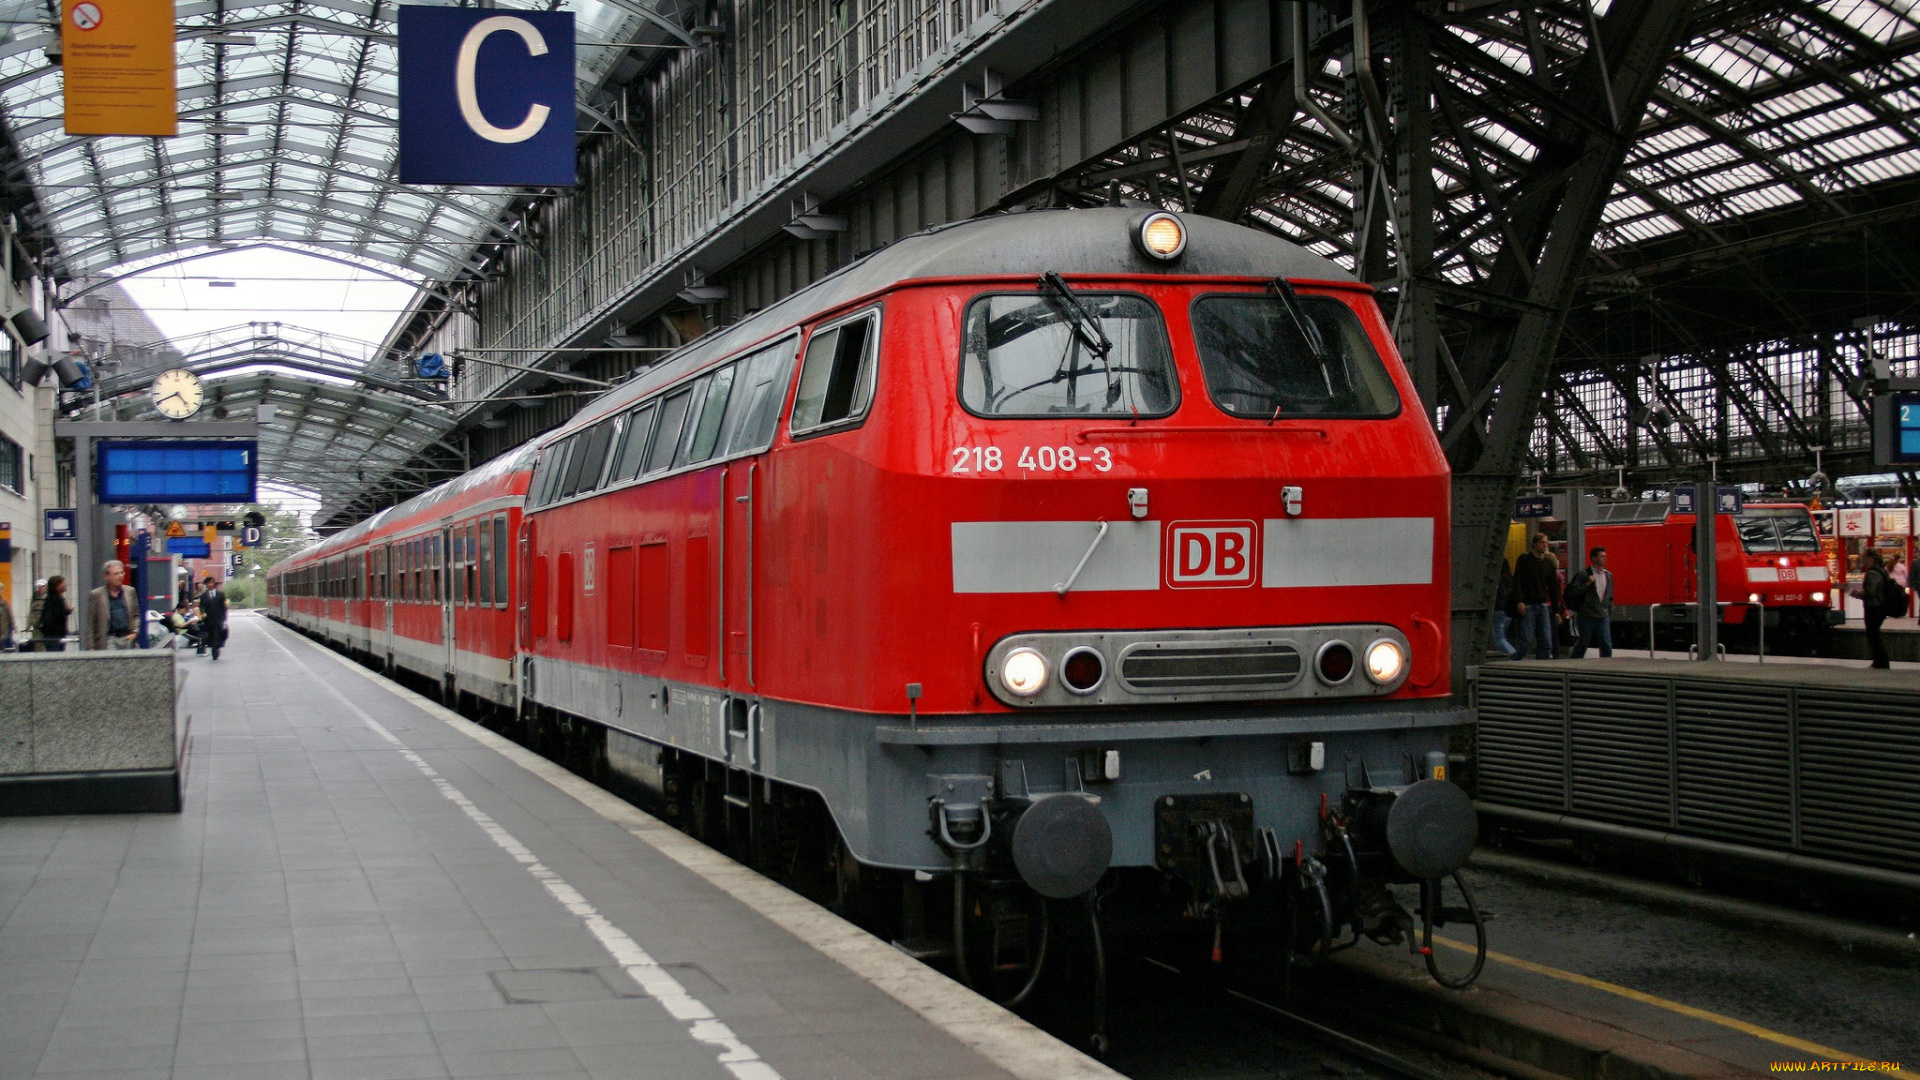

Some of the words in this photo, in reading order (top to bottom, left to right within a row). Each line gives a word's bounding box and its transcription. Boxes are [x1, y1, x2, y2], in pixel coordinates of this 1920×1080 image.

[456, 15, 551, 144] C
[1900, 404, 1911, 422] 2
[240, 450, 249, 465] 1
[952, 446, 1003, 473] 218
[1017, 446, 1113, 473] 408-3
[247, 527, 260, 543] D
[235, 554, 242, 564] E
[1178, 531, 1246, 577] DB
[1780, 570, 1795, 579] DB
